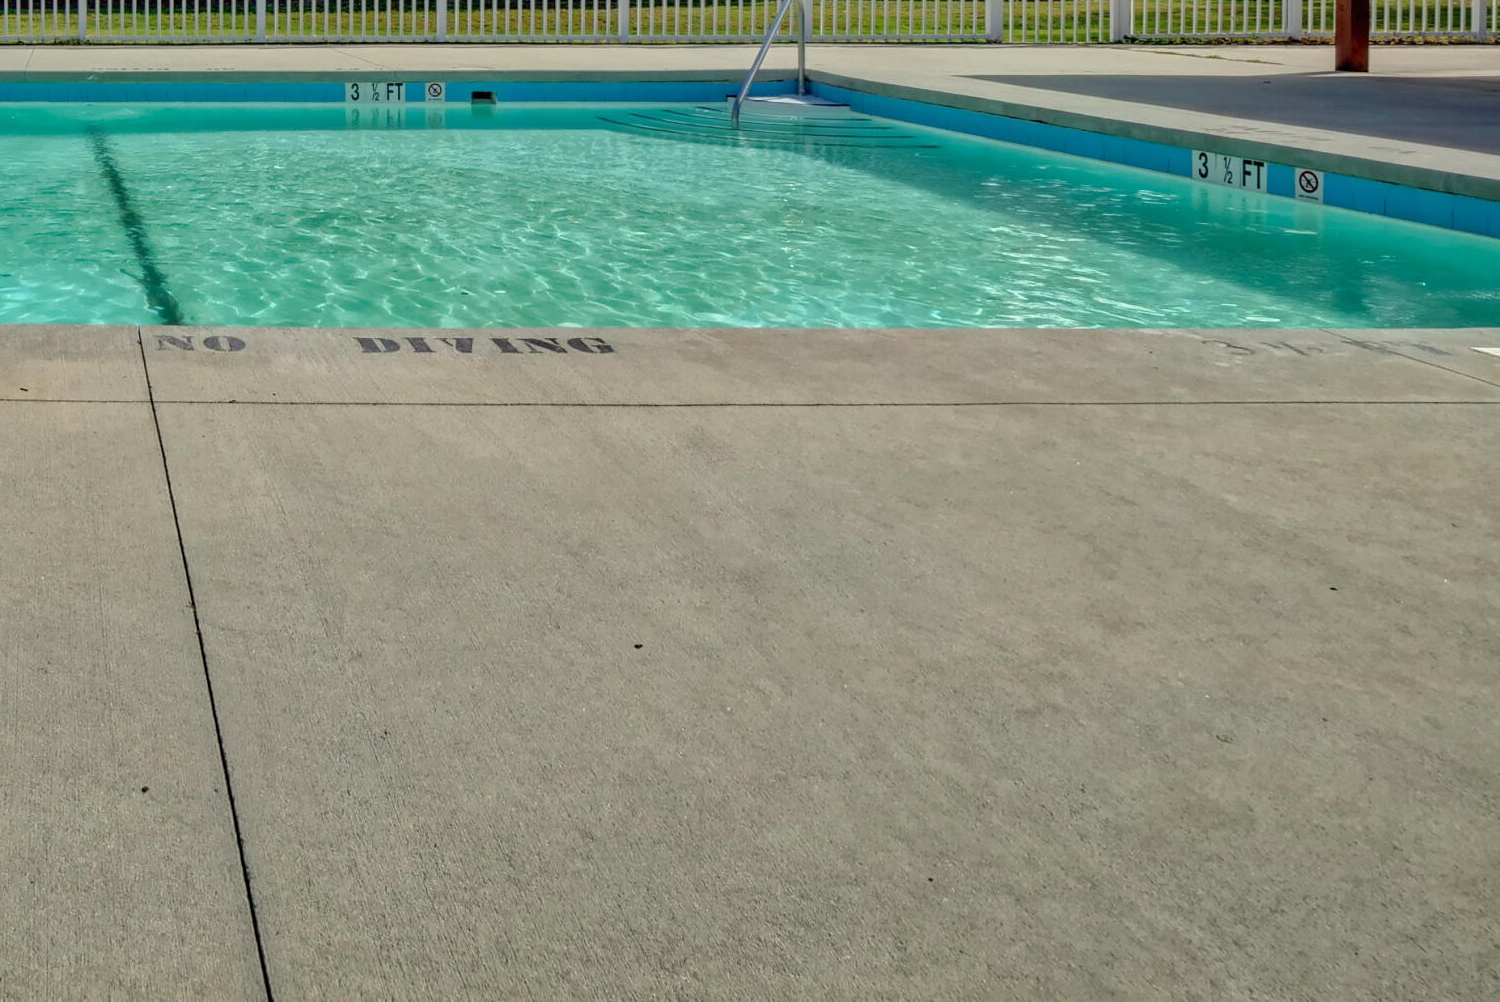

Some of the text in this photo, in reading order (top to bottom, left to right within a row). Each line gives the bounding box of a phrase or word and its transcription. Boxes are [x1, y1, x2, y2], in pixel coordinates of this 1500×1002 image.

[351, 83, 360, 101] 3
[386, 83, 403, 101] FT
[1198, 152, 1209, 179] 3
[1242, 159, 1265, 189] FT
[152, 335, 616, 354] NO DIVING
